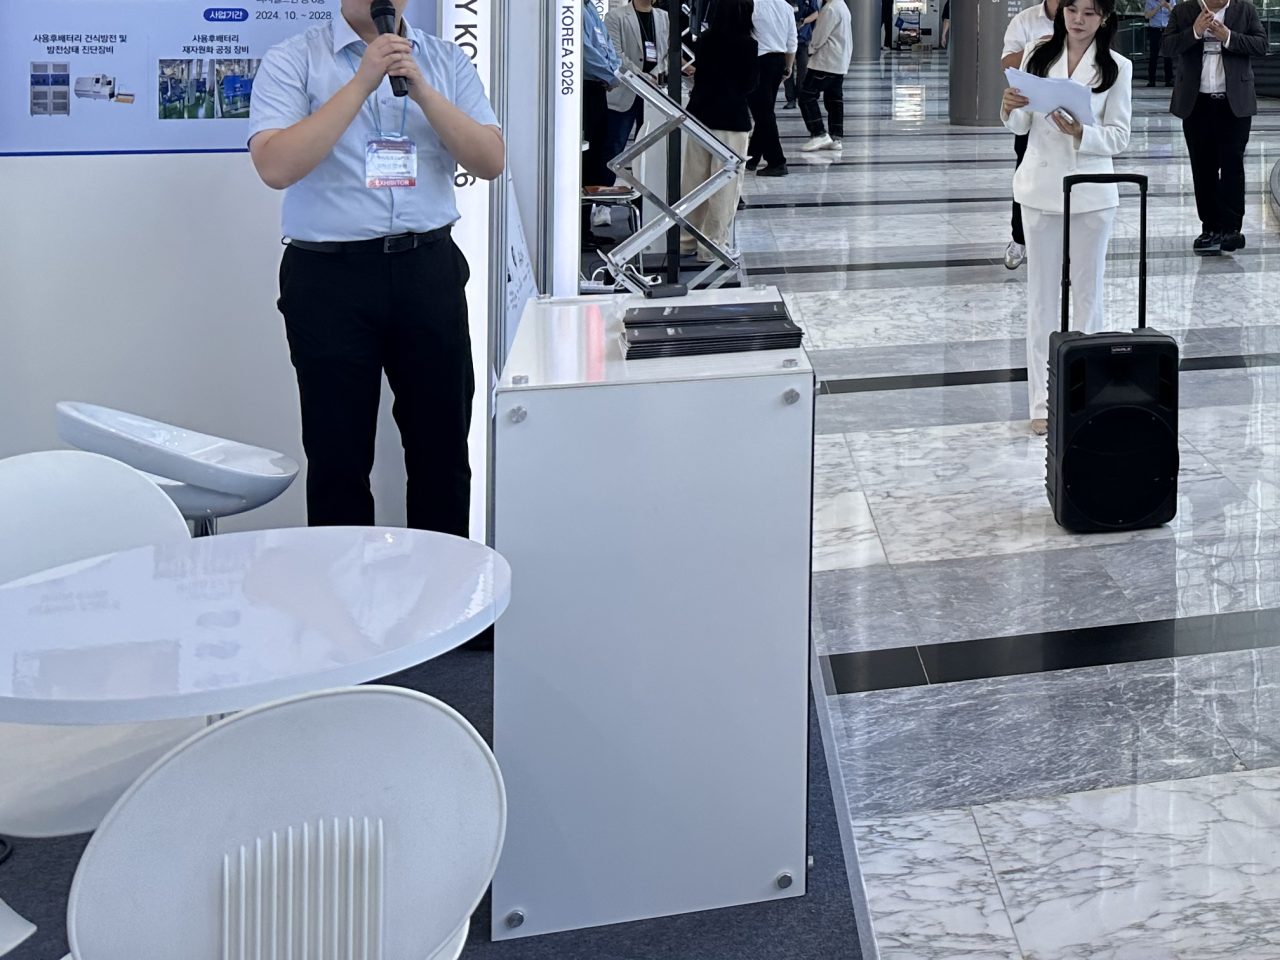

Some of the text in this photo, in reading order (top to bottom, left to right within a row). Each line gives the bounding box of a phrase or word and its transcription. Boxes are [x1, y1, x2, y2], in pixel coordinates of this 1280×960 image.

[209, 10, 243, 19] 사업기간
[255, 11, 281, 20] 2024.
[285, 11, 298, 20] 10.
[308, 11, 334, 21] 2028.
[561, 5, 575, 58] KOREA
[33, 33, 82, 43] 사용후배터리
[118, 34, 127, 44] 및
[192, 34, 239, 44] 사용후배터리
[81, 45, 114, 55] 진단장비
[182, 45, 249, 55] 재자원화 공정 장비
[561, 60, 574, 96] 2026
